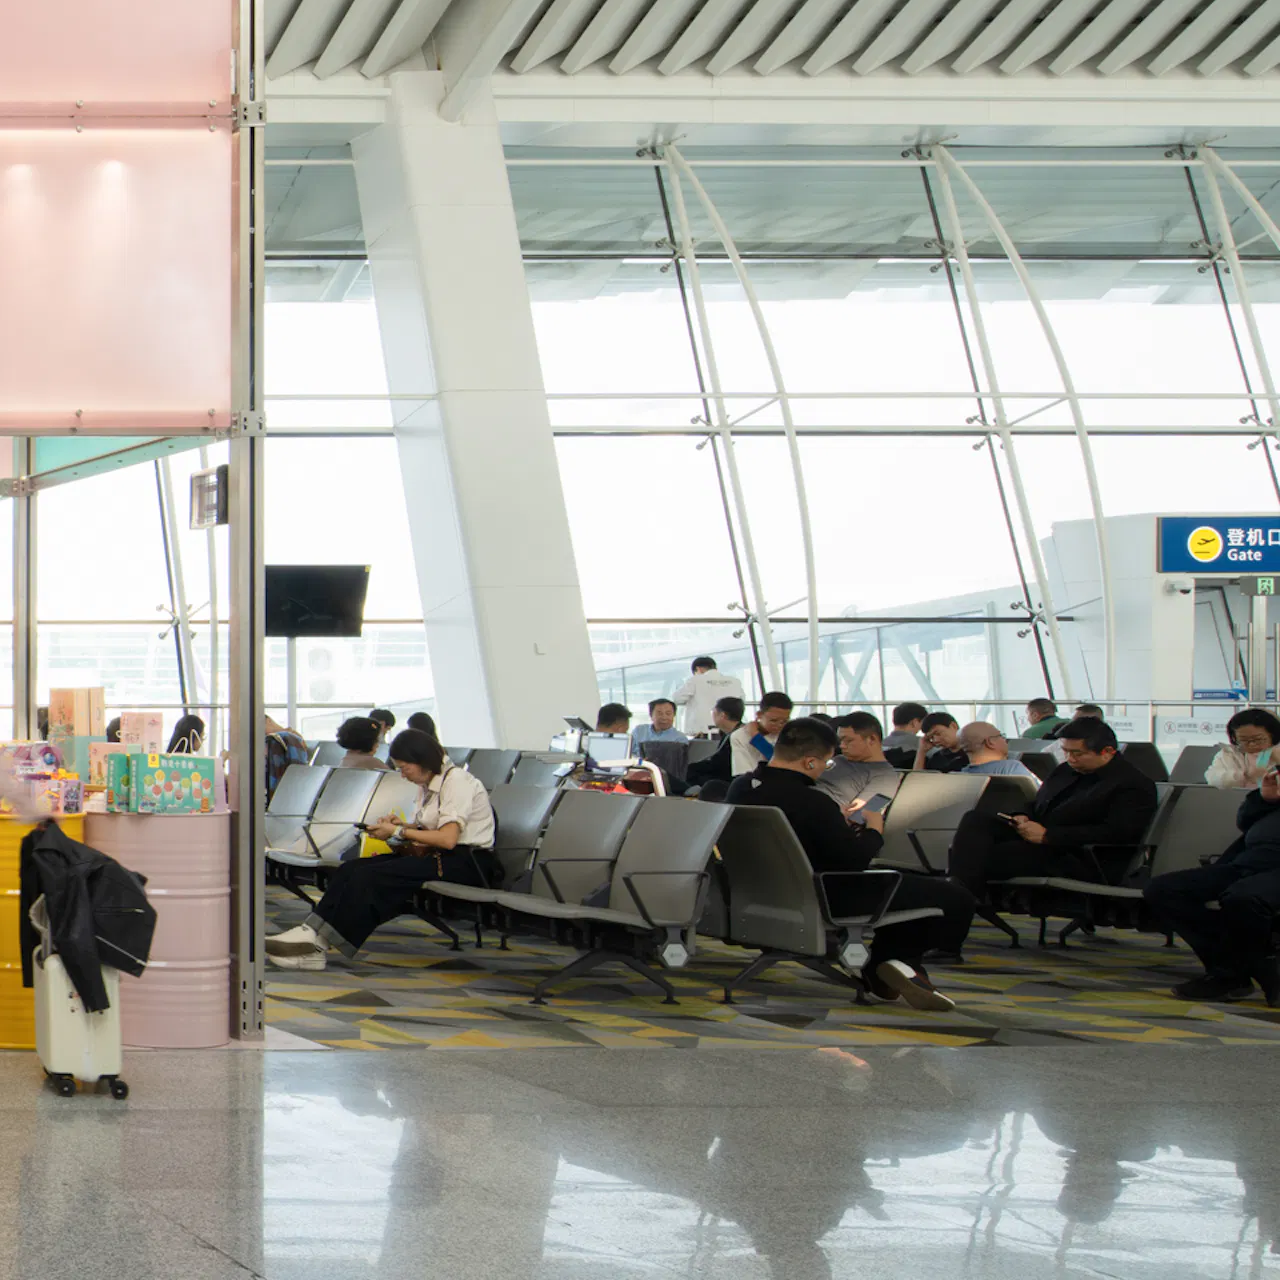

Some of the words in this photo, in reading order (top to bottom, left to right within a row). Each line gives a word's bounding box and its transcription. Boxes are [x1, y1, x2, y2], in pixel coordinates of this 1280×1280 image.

[1226, 528, 1280, 547] 登机口
[1227, 548, 1263, 562] Gate
